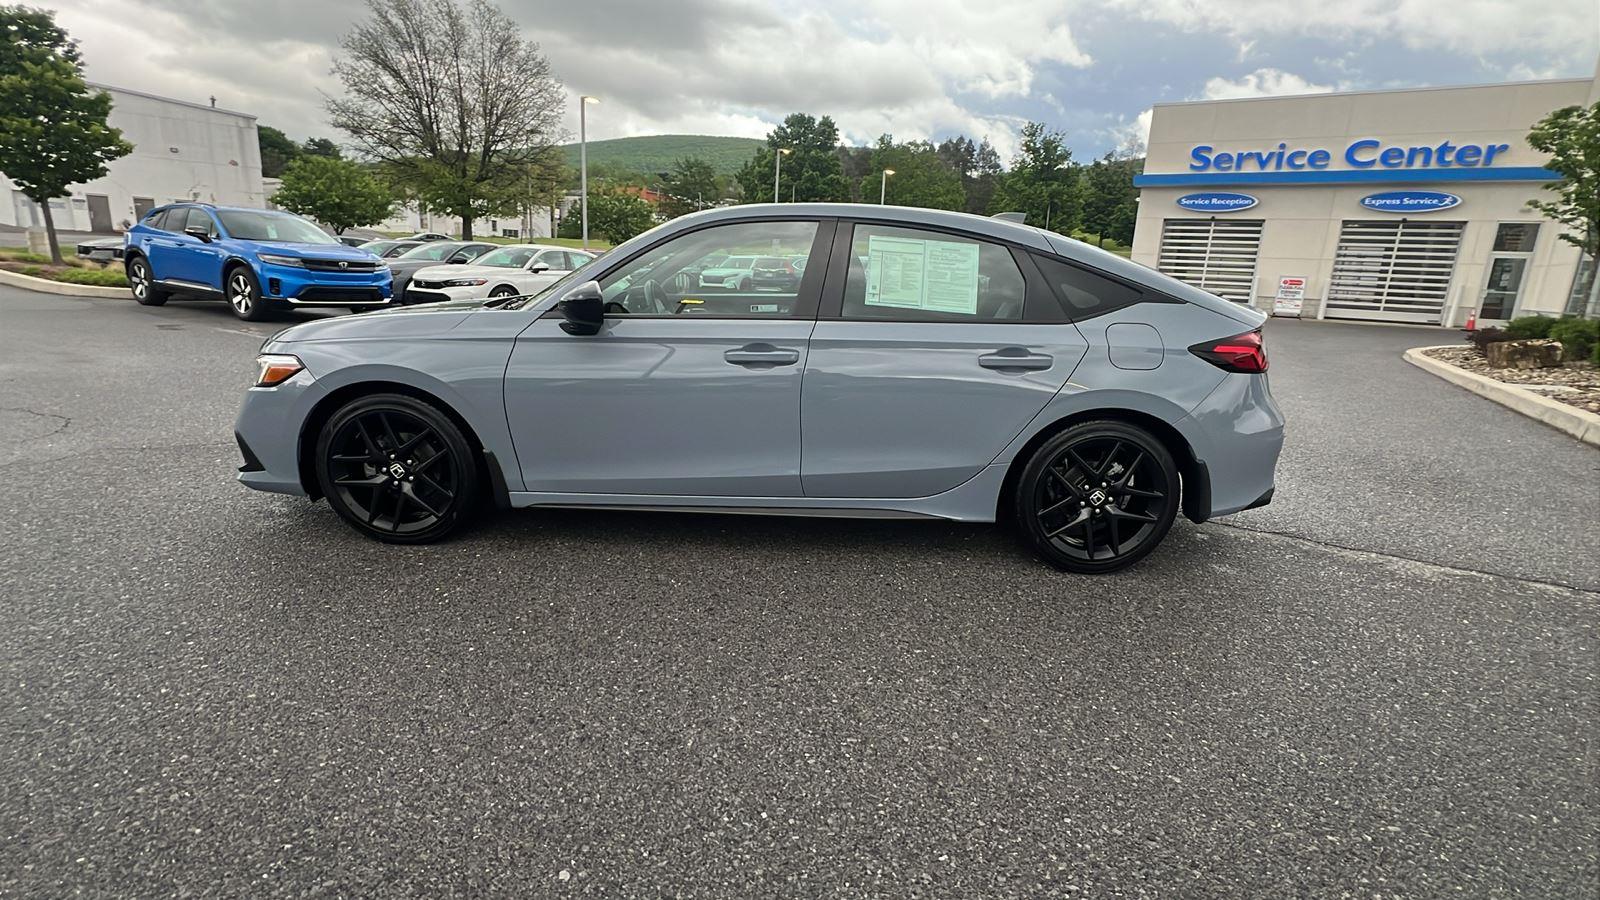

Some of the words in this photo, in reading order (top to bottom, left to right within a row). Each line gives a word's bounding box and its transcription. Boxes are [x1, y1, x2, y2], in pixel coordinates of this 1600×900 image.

[1189, 142, 1331, 171] Service
[1344, 139, 1510, 168] Center
[1211, 197, 1253, 207] Reception
[1364, 197, 1401, 206] Express
[1402, 197, 1439, 205] Service
